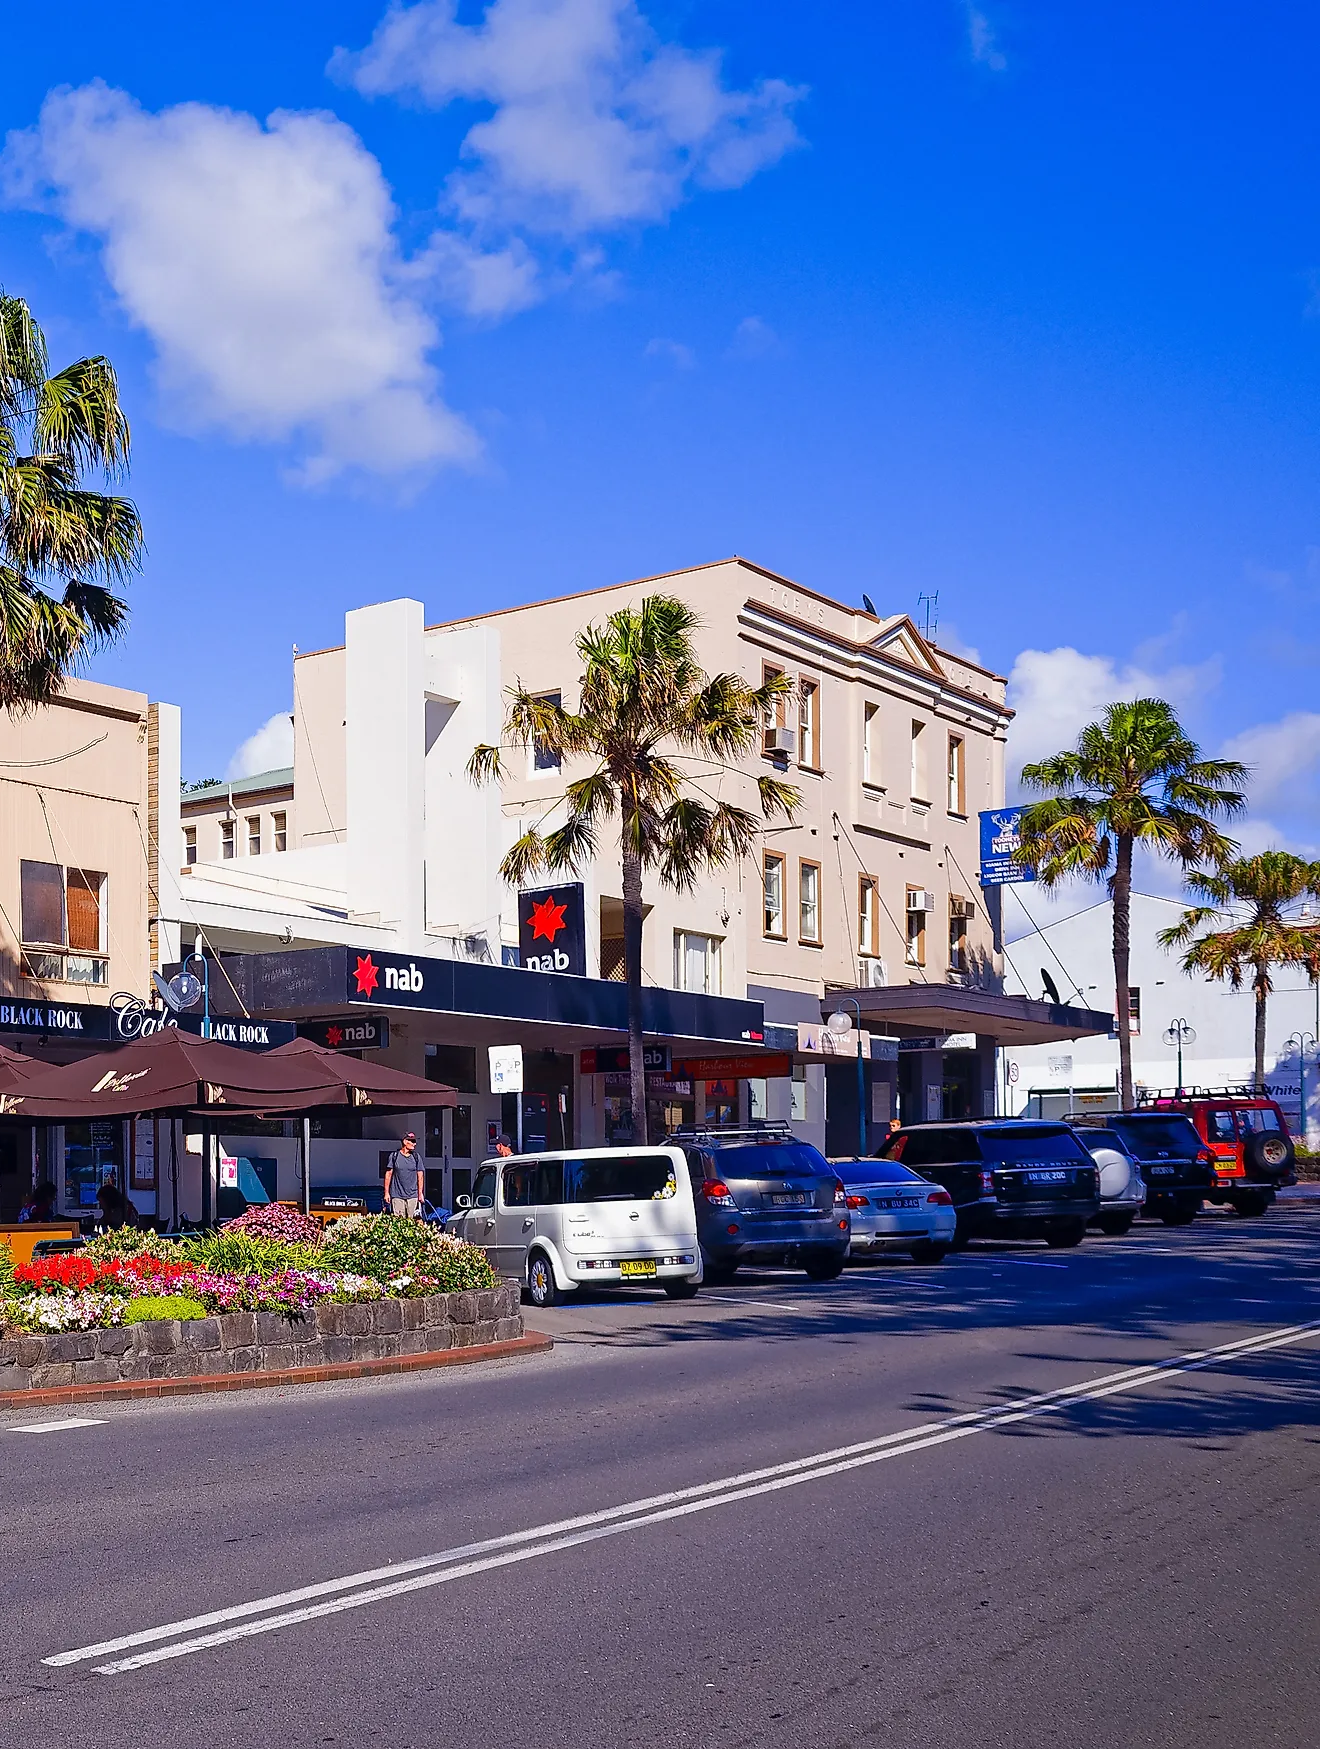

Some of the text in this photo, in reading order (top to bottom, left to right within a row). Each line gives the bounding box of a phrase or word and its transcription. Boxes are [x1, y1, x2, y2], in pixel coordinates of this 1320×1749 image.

[991, 842, 1021, 854] NEW
[526, 949, 570, 972] nab
[385, 963, 424, 993] nab
[0, 1005, 83, 1030] BLACK ROCK
[239, 1026, 269, 1044] ROCK
[344, 1023, 376, 1042] nab
[643, 1050, 662, 1065] ab
